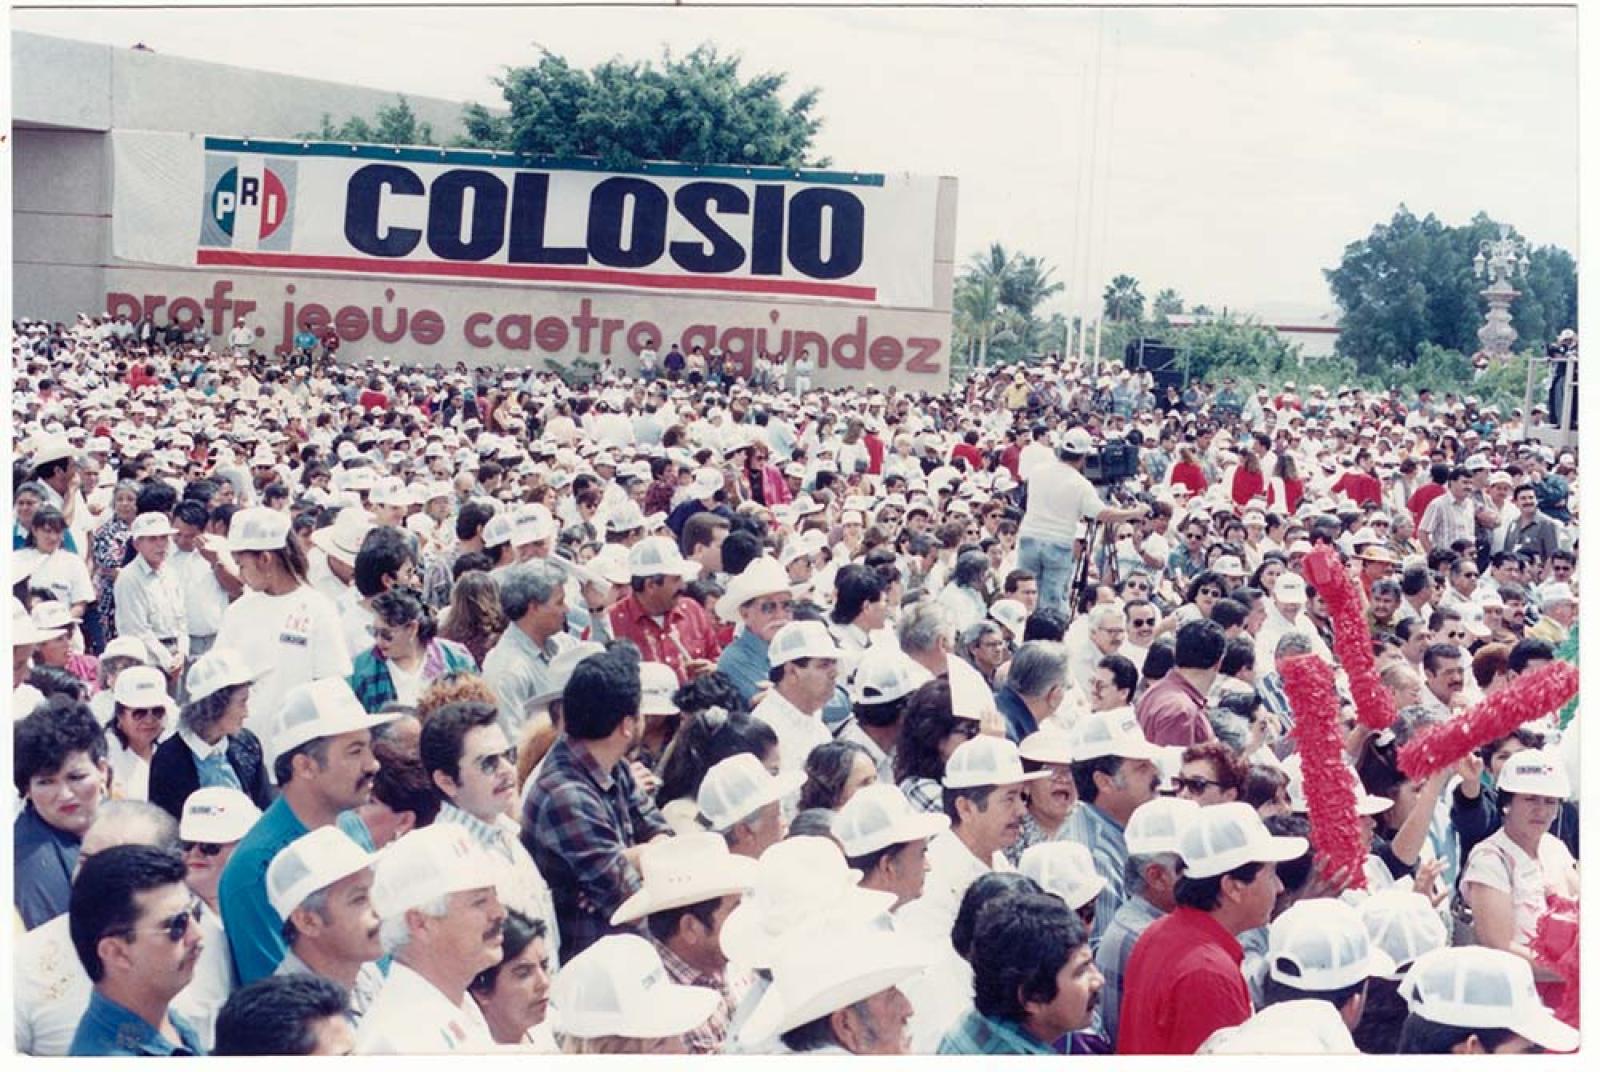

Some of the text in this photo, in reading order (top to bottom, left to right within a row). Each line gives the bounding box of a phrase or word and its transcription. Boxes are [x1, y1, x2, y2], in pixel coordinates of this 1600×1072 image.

[216, 177, 278, 225] PRI
[344, 164, 865, 280] COLOSIO
[464, 298, 662, 354] castro
